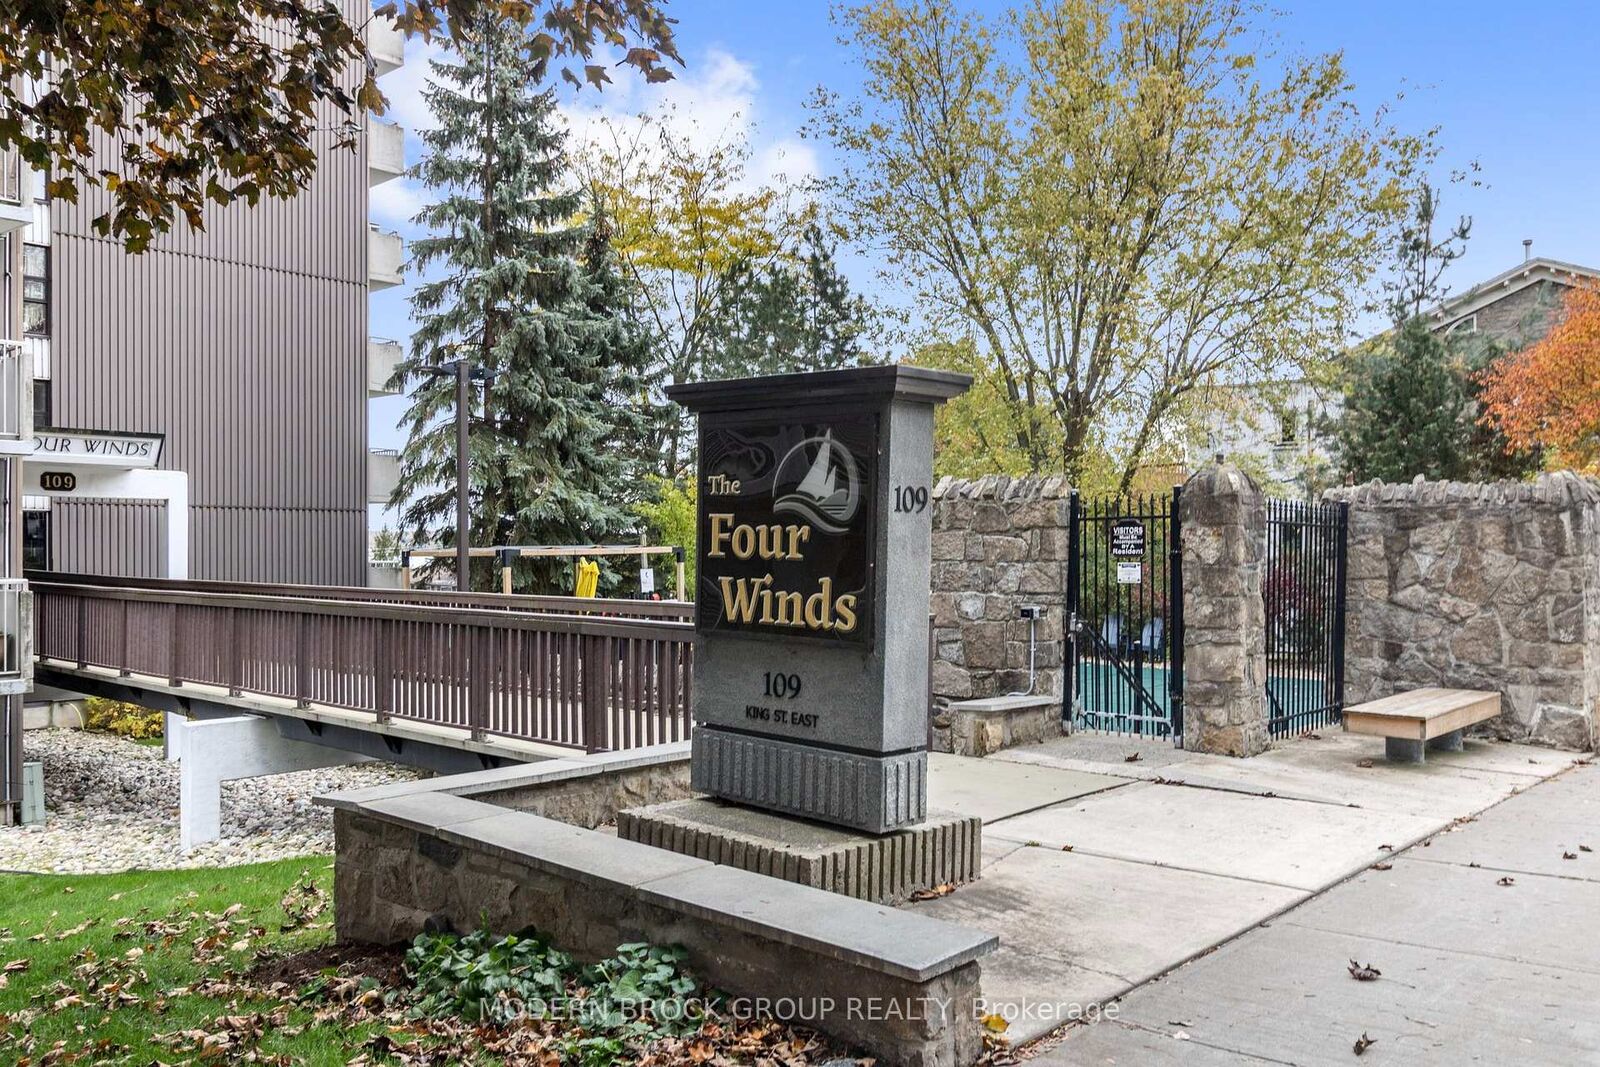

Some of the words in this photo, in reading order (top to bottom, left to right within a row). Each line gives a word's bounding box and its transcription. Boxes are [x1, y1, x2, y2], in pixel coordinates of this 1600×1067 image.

[84, 439, 149, 456] WINDS
[44, 474, 73, 488] 109
[707, 474, 741, 495] The
[894, 485, 928, 514] 109
[707, 513, 811, 561] Four
[1113, 526, 1144, 535] VISITORS
[718, 573, 858, 632] Winds
[763, 671, 802, 699] 109
[745, 704, 770, 721] KING
[791, 711, 819, 729] EAST
